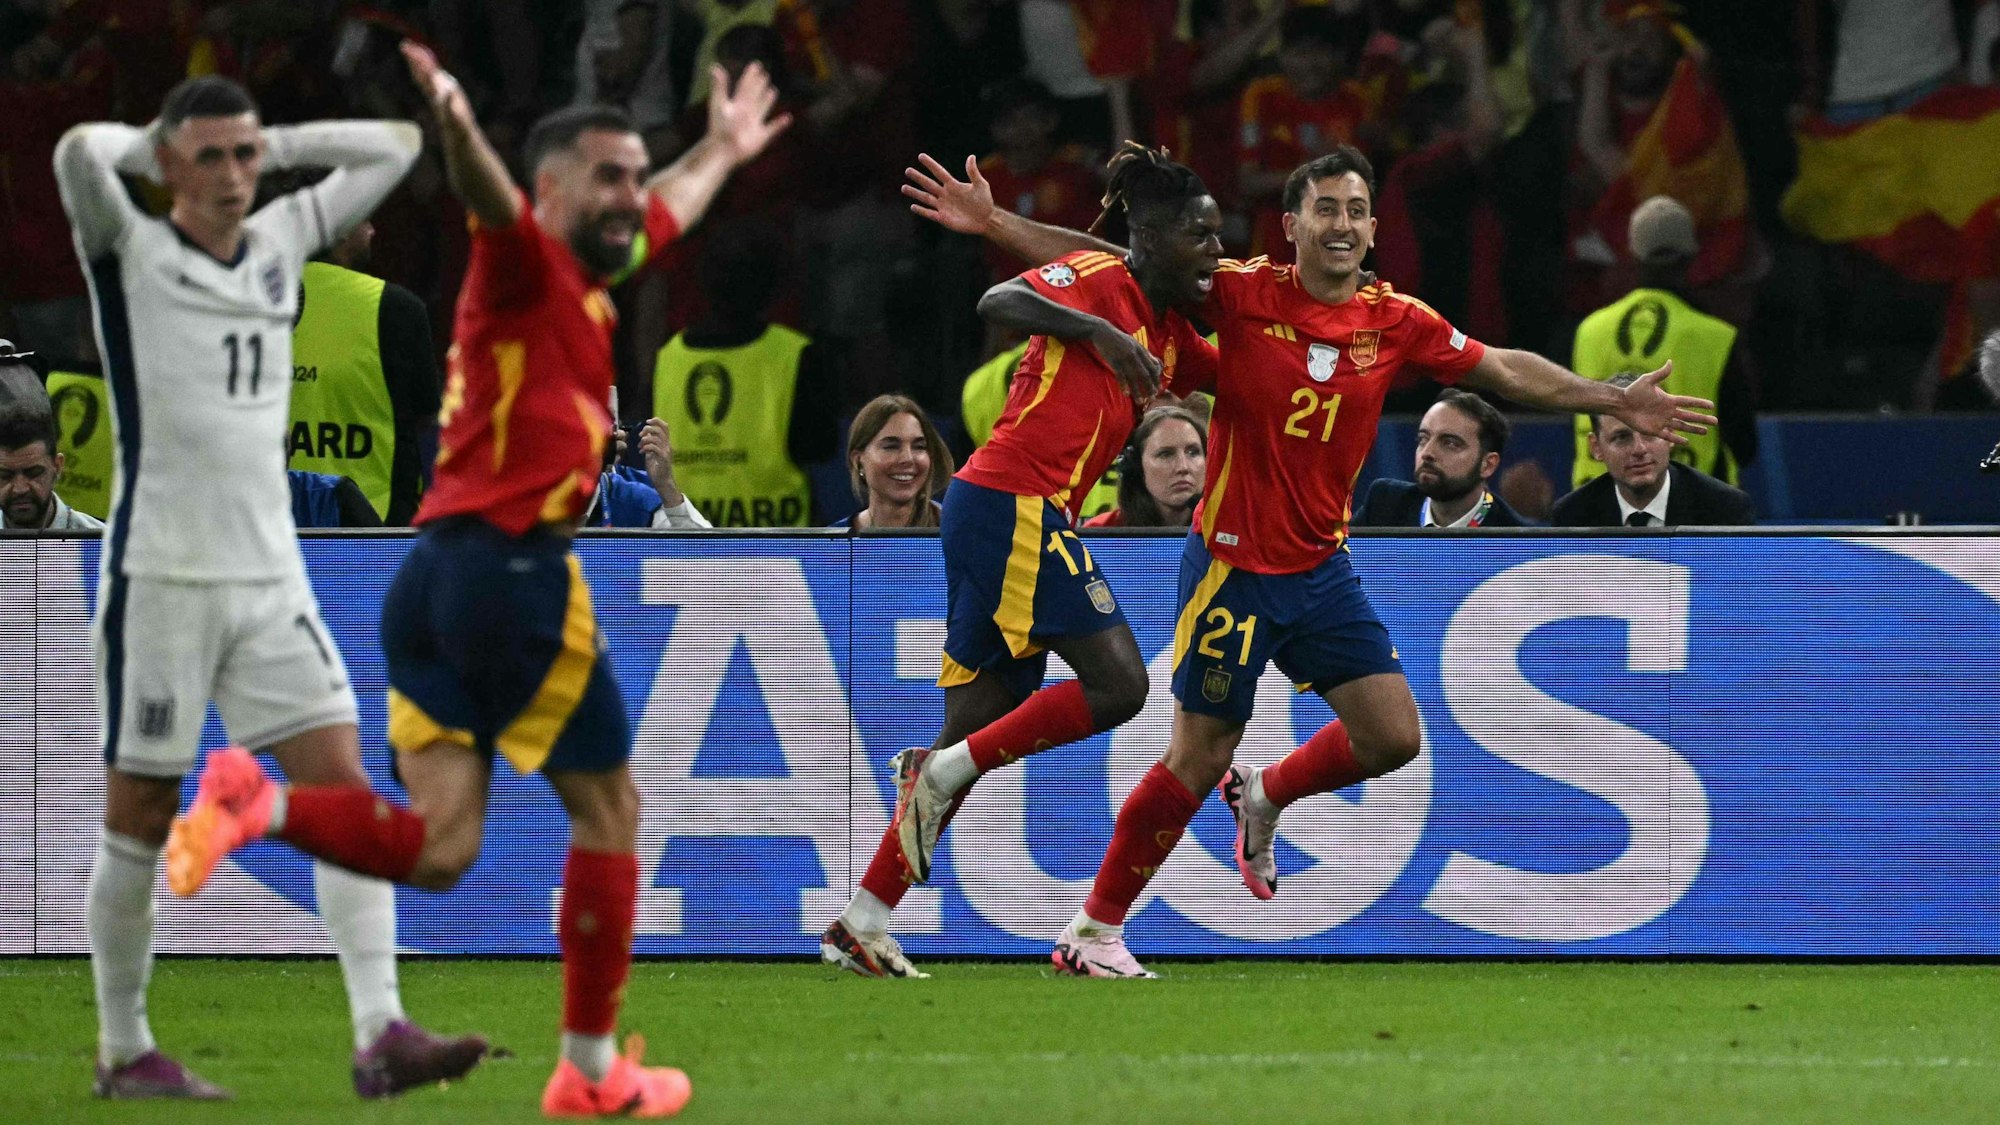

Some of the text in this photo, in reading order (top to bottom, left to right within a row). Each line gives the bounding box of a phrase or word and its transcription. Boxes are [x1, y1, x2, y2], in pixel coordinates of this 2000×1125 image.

[223, 332, 262, 397] 11
[1283, 386, 1342, 442] 21
[1047, 530, 1093, 576] 17
[1198, 607, 1257, 666] 21
